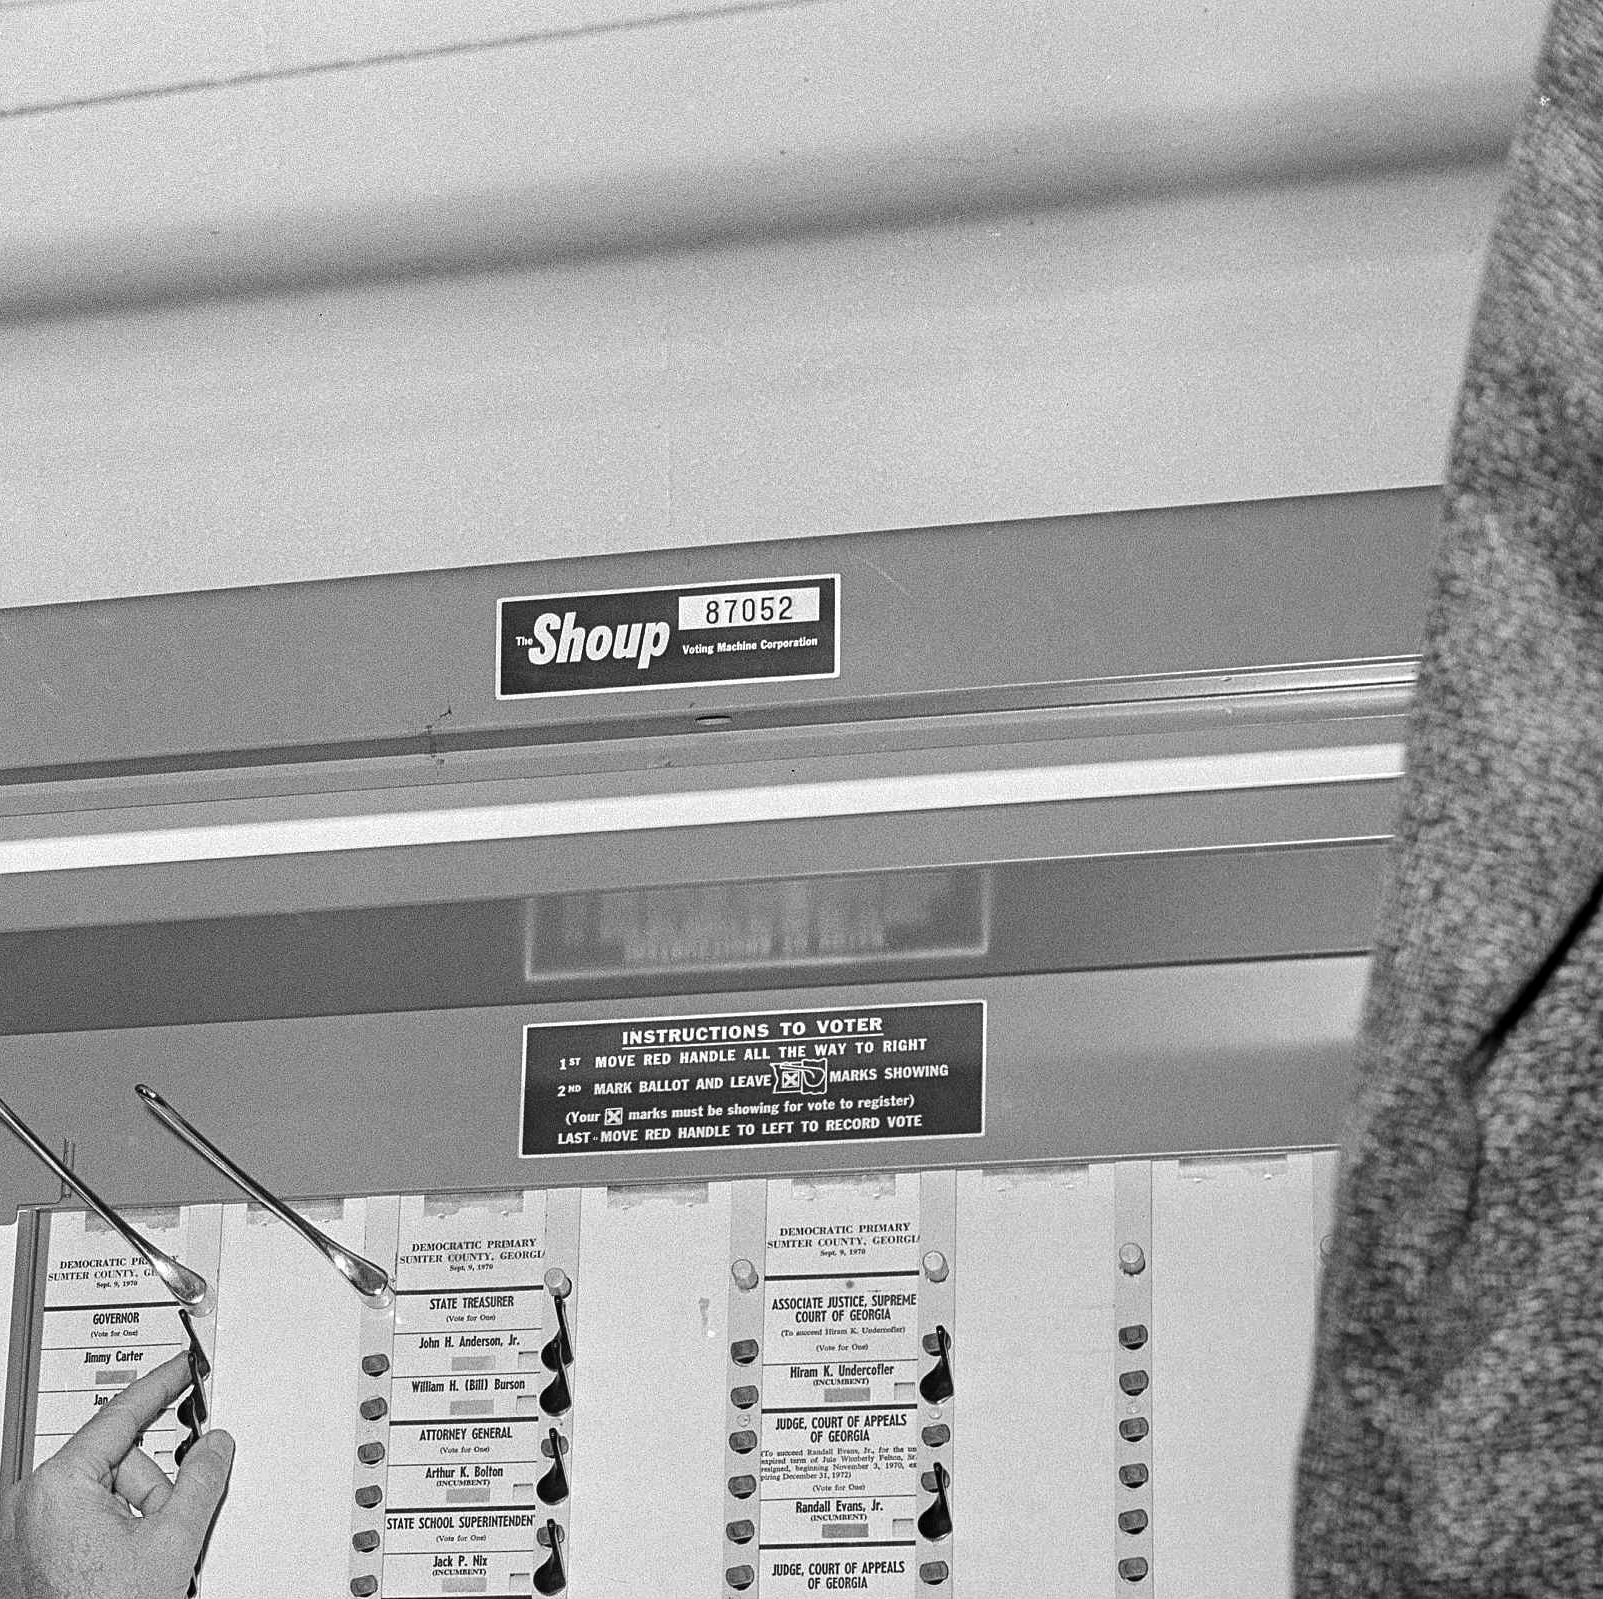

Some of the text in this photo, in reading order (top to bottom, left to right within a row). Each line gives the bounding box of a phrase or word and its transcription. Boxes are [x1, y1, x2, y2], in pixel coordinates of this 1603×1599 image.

[706, 596, 794, 624] 87052
[516, 611, 670, 670] The Shoup
[682, 636, 817, 654] Voting Machine Corporation
[622, 1017, 882, 1044] INSTRUCTIONS TO VOTER
[595, 1054, 635, 1068] MOVE
[643, 1052, 671, 1066] RED
[679, 1049, 735, 1063] HANDLE
[743, 1047, 770, 1060] ALL
[778, 1045, 808, 1058] THE
[815, 1043, 847, 1056] WAY
[854, 1041, 874, 1054] TO
[882, 1038, 927, 1052] RIGHT
[593, 1081, 632, 1095] MARK
[638, 1078, 689, 1093] BALLOT
[695, 1077, 723, 1090] AND
[730, 1074, 771, 1088] LEAVE
[826, 1067, 877, 1082] MARKS
[884, 1063, 948, 1079] SHOWING
[565, 1094, 914, 1125] (Your marks must be showing for vote to register)
[600, 1129, 638, 1142] MOVE
[644, 1127, 671, 1140] RED
[678, 1124, 730, 1139] HANDLE
[736, 1123, 755, 1136] TO
[761, 1121, 794, 1134] LEFT
[800, 1120, 818, 1132] TO
[825, 1117, 880, 1131] RECORD
[887, 1114, 922, 1128] VOTE
[412, 1238, 536, 1251] DEMOCRATIC PRIMARY
[59, 1258, 126, 1269] DEMOCRATIC
[429, 1295, 514, 1310] STATE TREASURER
[92, 1311, 139, 1325] GOVERNOR
[418, 1333, 520, 1349] John H. Anderson, Jr.
[83, 1350, 143, 1365] Jimmy Carter
[790, 1362, 894, 1378] Hiram K. Undercofler
[411, 1378, 525, 1392] William H. (Bill) Burson
[419, 1426, 512, 1441] ATTORNEY GENERAL
[425, 1465, 503, 1478] Arthur K. Bolton
[436, 1479, 490, 1487] (INCUMBENT)
[795, 1498, 883, 1513] Randall Evans, Jr.
[771, 1560, 905, 1576] JUDGE, COURT OF APPEALS
[807, 1576, 867, 1589] OF GEORGIA
